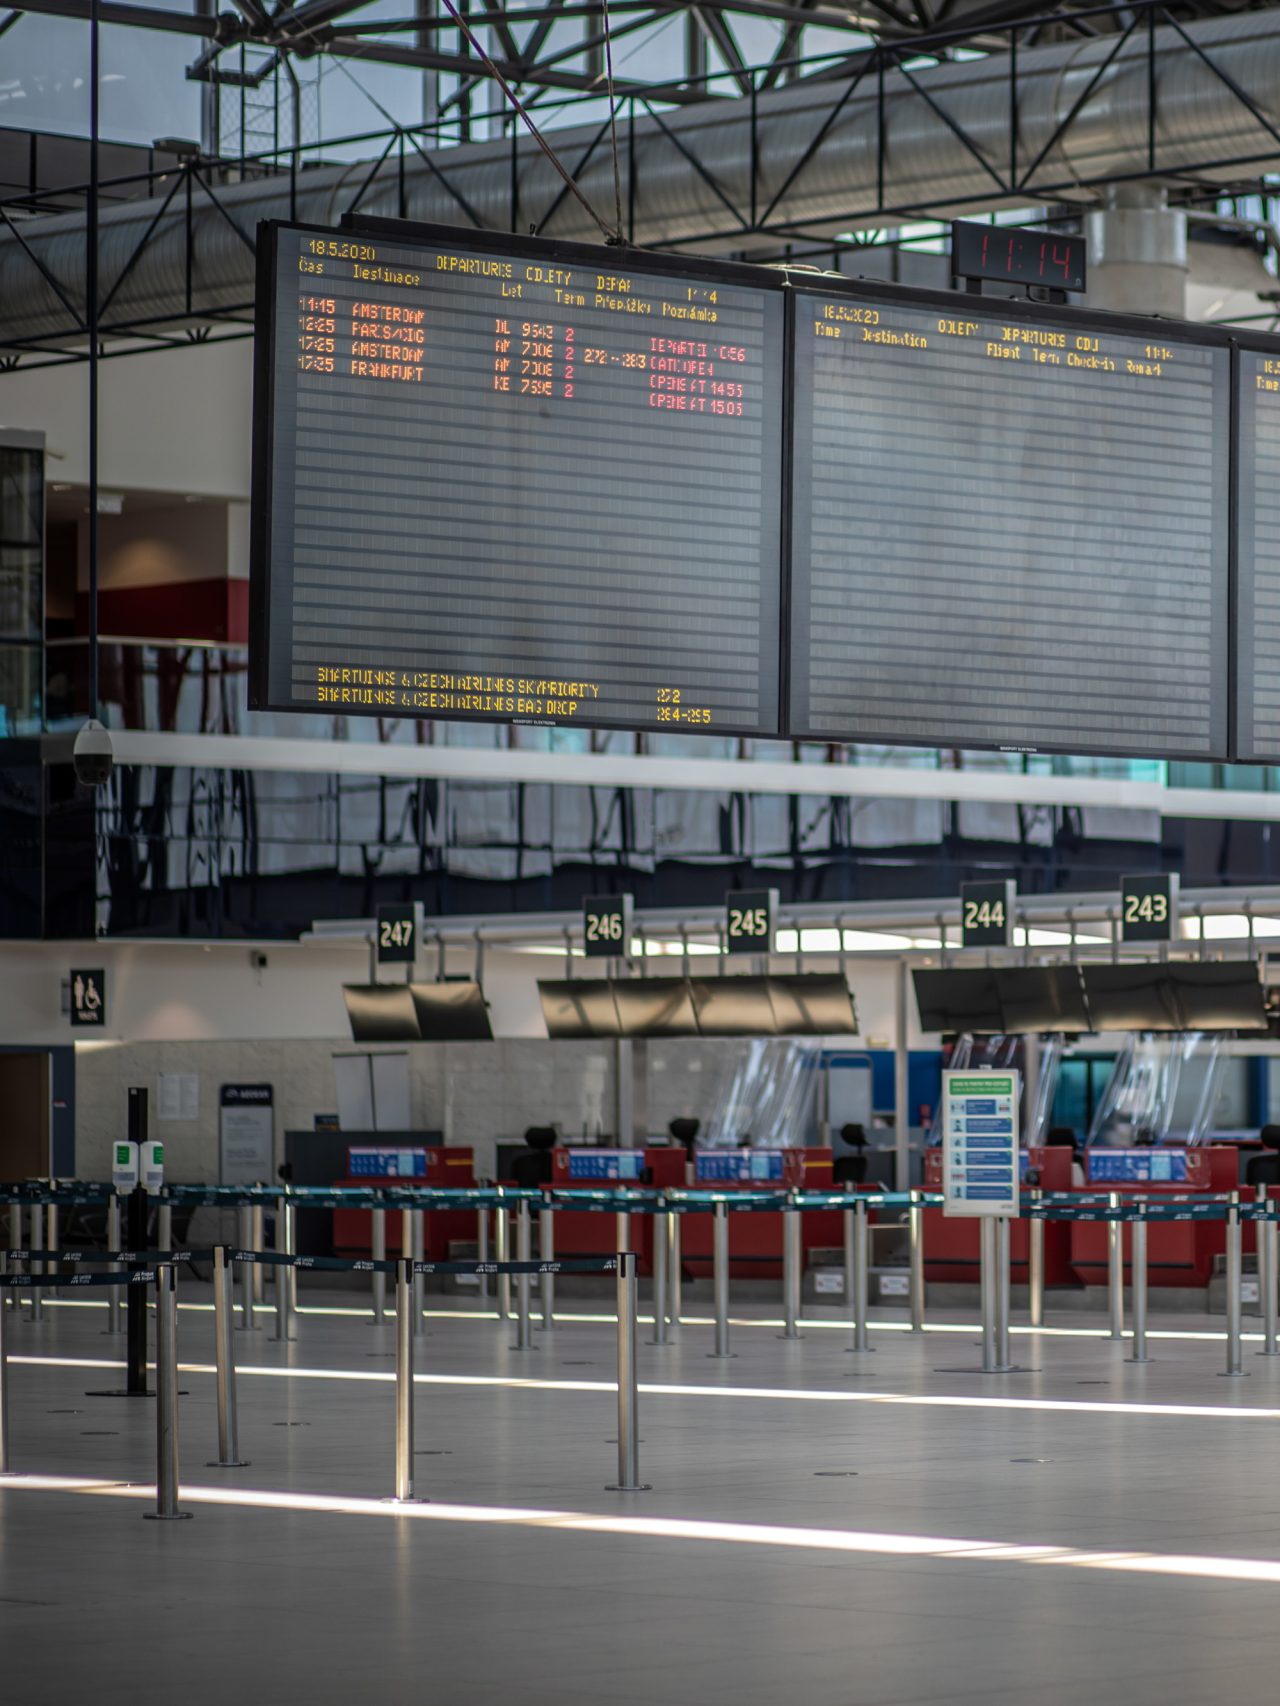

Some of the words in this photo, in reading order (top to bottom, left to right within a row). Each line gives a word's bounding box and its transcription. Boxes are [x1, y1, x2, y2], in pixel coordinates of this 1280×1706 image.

[309, 239, 376, 261] 18.5.2020
[436, 256, 512, 278] DEPARTURES
[981, 234, 1071, 280] 11:14
[502, 283, 523, 298] Let
[555, 289, 585, 306] Term
[352, 303, 425, 325] AMSTERDAM
[565, 327, 575, 342] 2
[815, 321, 841, 338] Time
[863, 328, 927, 348] Destination
[987, 343, 1020, 360] Flight
[1002, 327, 1066, 348] DEPARTURES
[352, 341, 425, 363] AMSTERDAM
[565, 365, 575, 380] 2
[565, 346, 575, 361] 2
[351, 360, 424, 382] FRANKFURT
[564, 383, 574, 398] 2
[1256, 376, 1279, 391] Time
[414, 673, 454, 690] CZECH
[458, 675, 514, 693] AIRLINES
[414, 692, 454, 709] CZECH
[457, 694, 514, 712] AIRLINES
[965, 901, 1005, 929] 244
[1125, 894, 1167, 922] 243
[380, 920, 413, 948] 247
[587, 913, 623, 941] 246
[729, 909, 768, 937] 245
